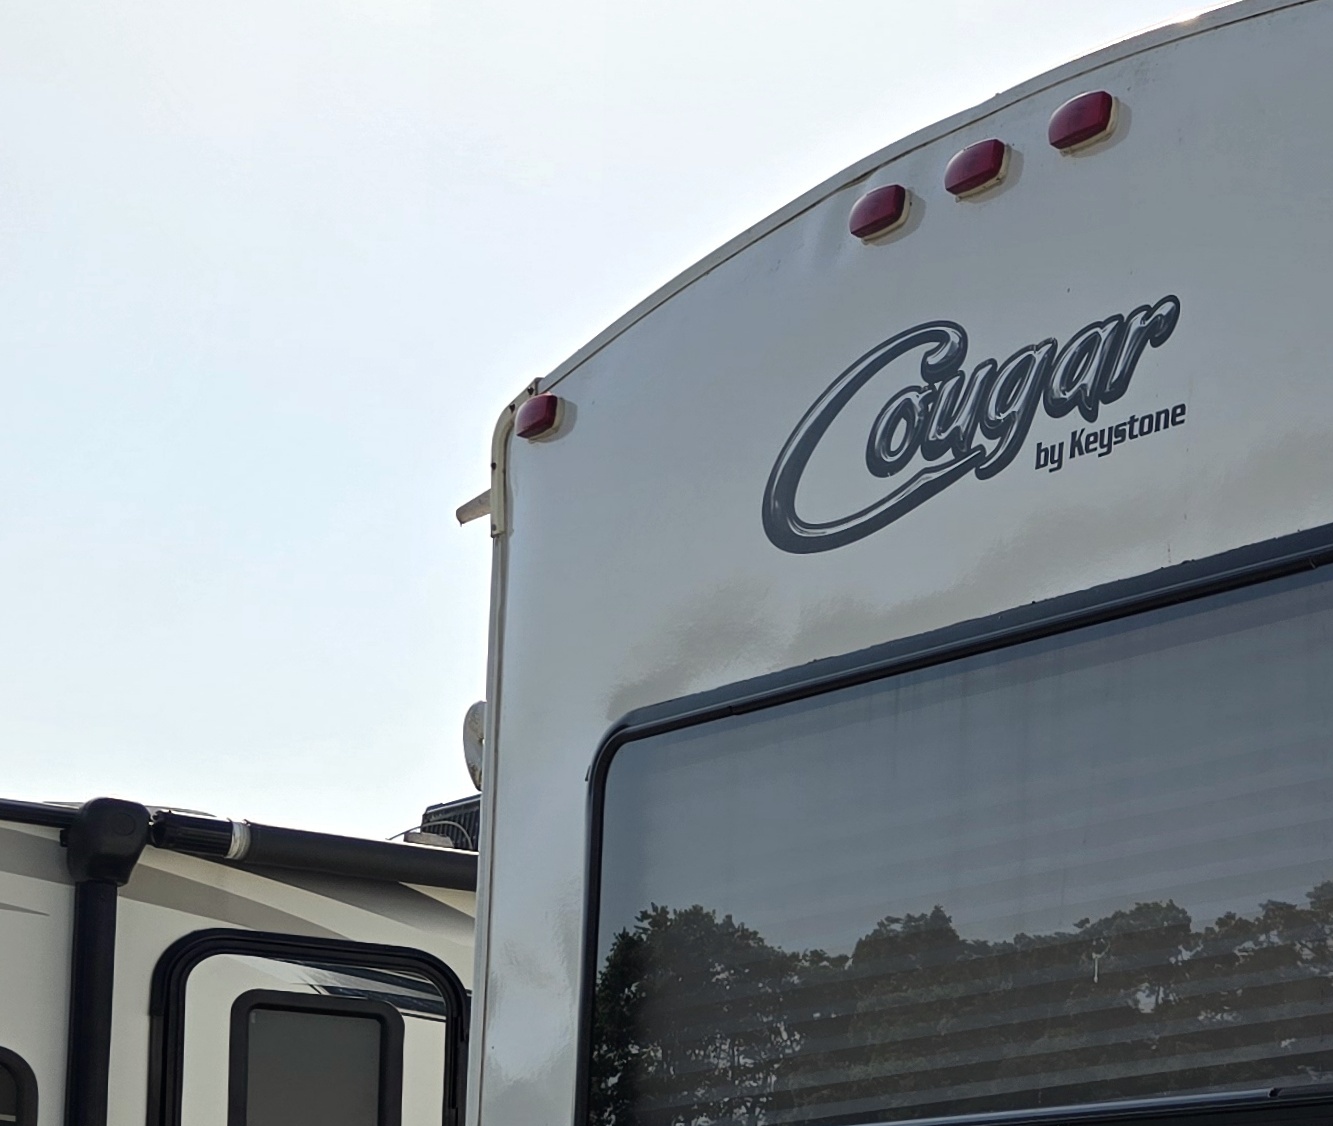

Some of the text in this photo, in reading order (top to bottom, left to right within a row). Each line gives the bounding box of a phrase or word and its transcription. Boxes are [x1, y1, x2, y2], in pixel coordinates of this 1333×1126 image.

[762, 295, 1180, 553] Cougar
[1035, 403, 1186, 472] by Keystone
